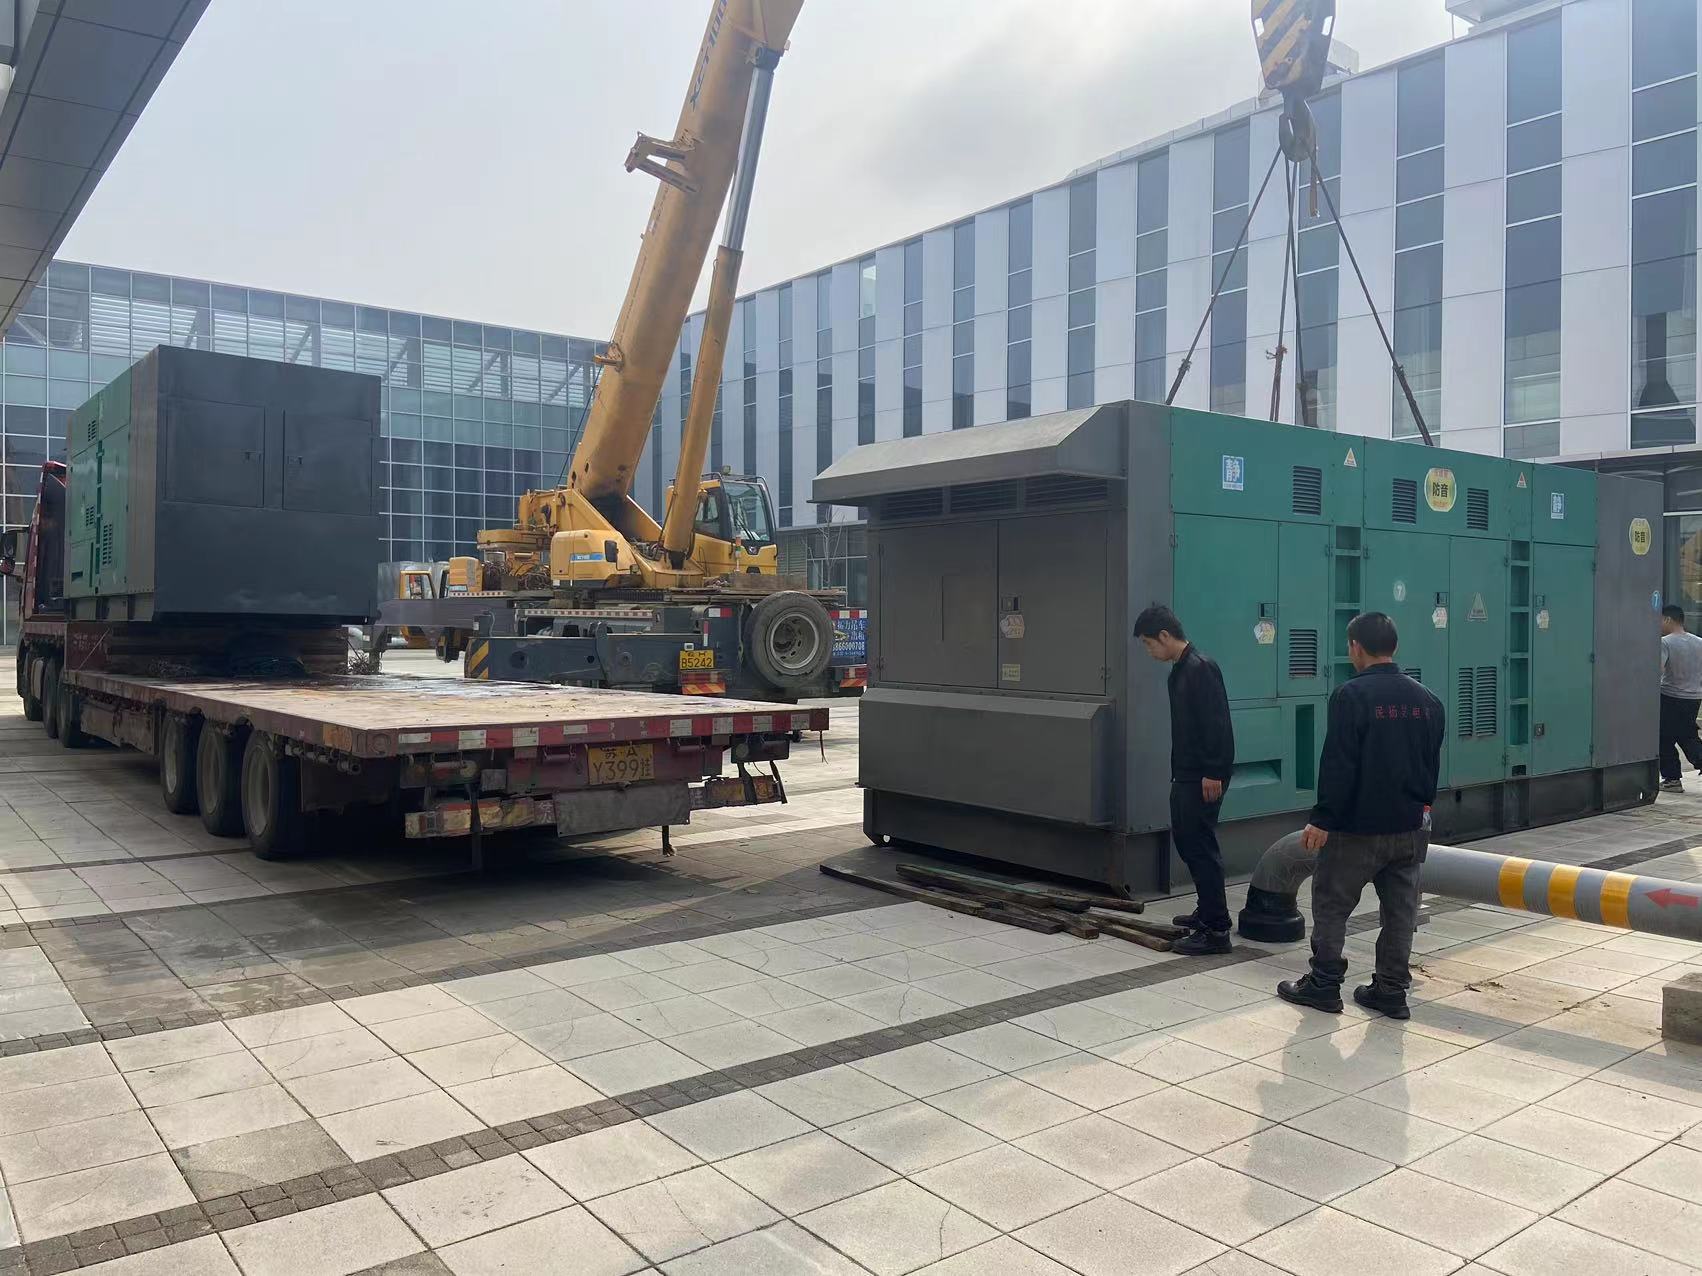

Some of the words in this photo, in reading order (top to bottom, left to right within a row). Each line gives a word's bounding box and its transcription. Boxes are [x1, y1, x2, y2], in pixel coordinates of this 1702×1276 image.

[1225, 458, 1240, 482] 静
[1432, 482, 1448, 497] 防音
[682, 658, 712, 668] B5242
[593, 758, 650, 782] Y399挂
